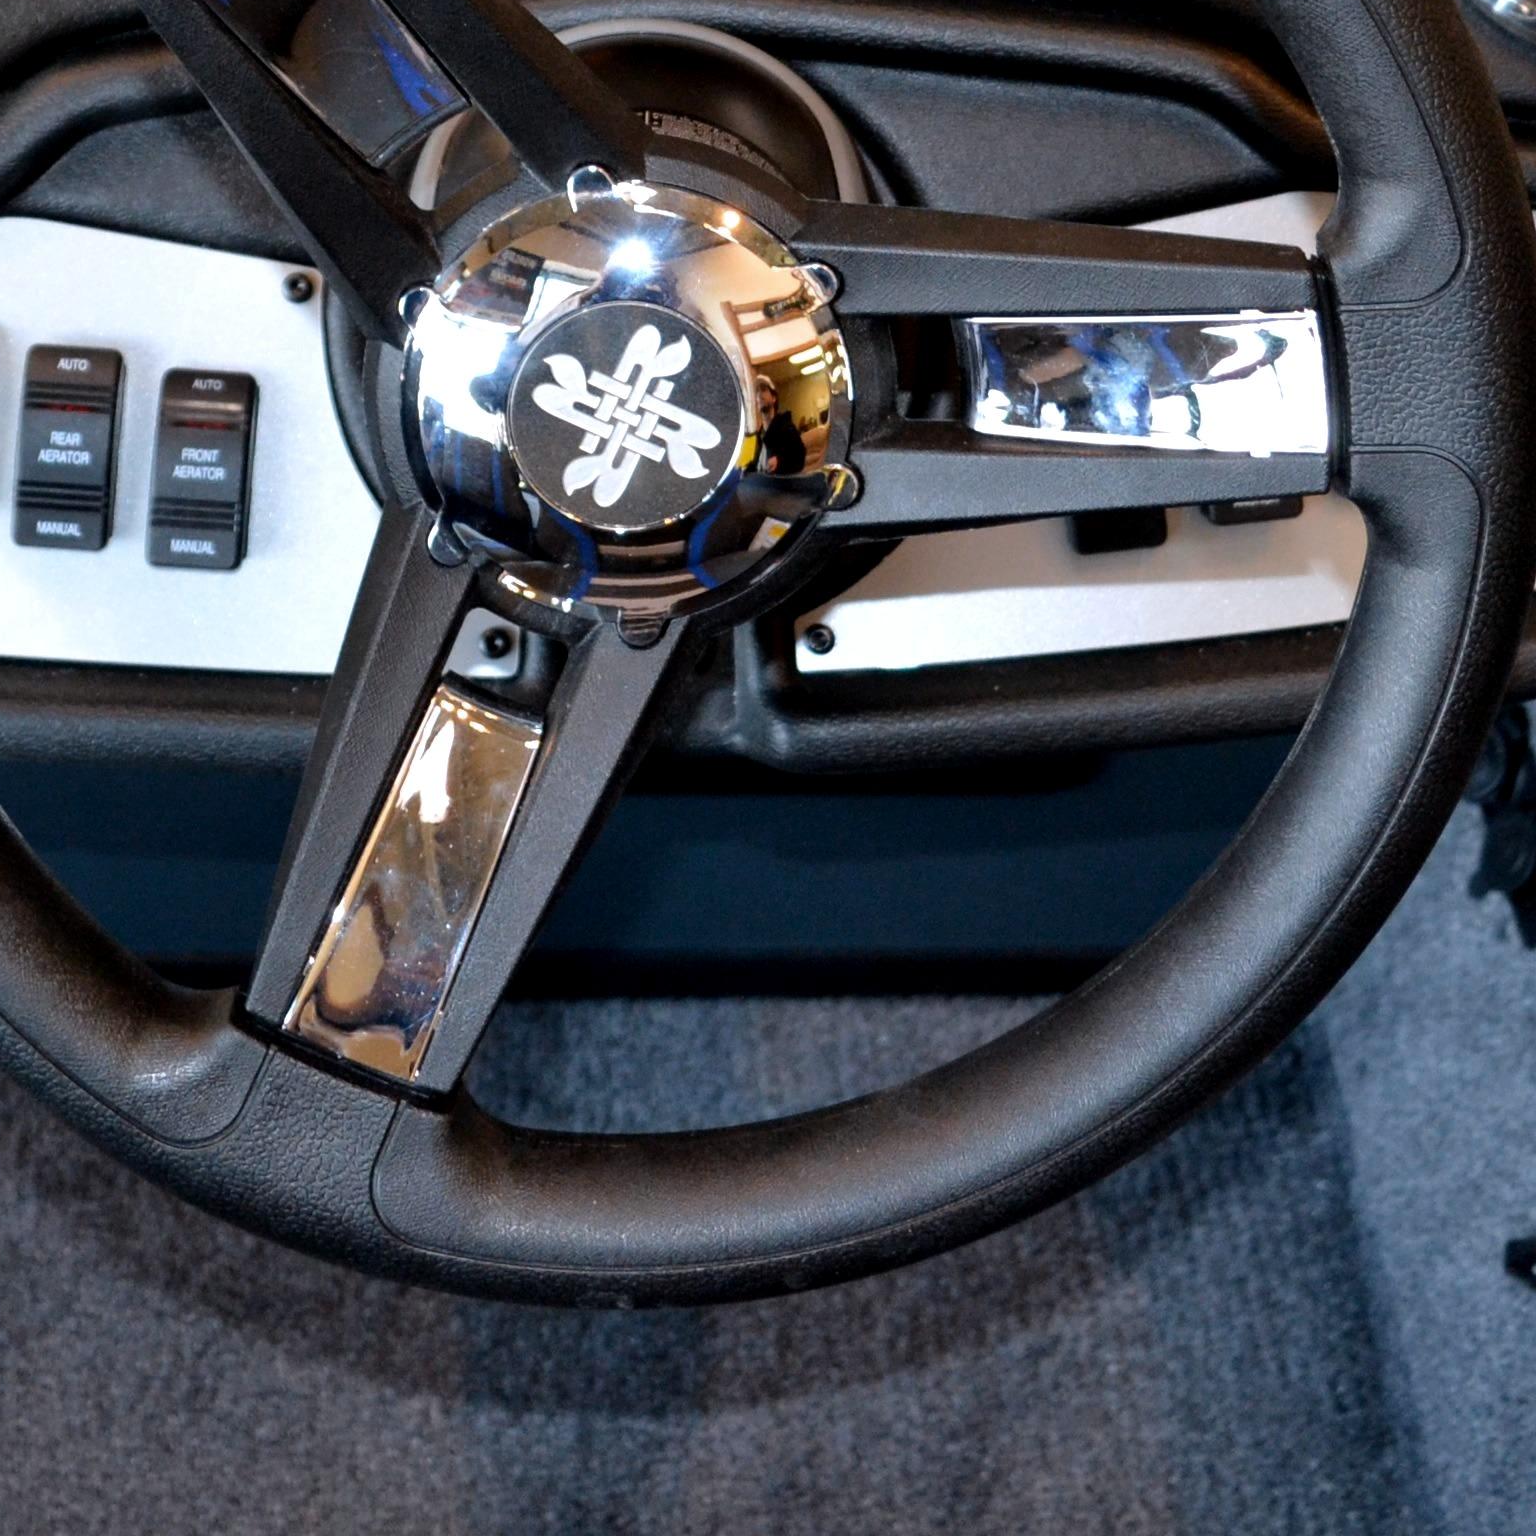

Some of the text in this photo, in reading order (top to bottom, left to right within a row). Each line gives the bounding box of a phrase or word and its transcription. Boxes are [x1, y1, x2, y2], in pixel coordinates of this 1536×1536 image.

[56, 357, 89, 372] AUTO
[191, 377, 223, 391] AUTO
[49, 430, 81, 447] REAR
[37, 448, 89, 465] AERATOR
[180, 447, 220, 463] FRONT
[172, 465, 226, 481] AERATOR
[36, 521, 82, 538] MANUAL
[169, 538, 216, 556] MANUAL
